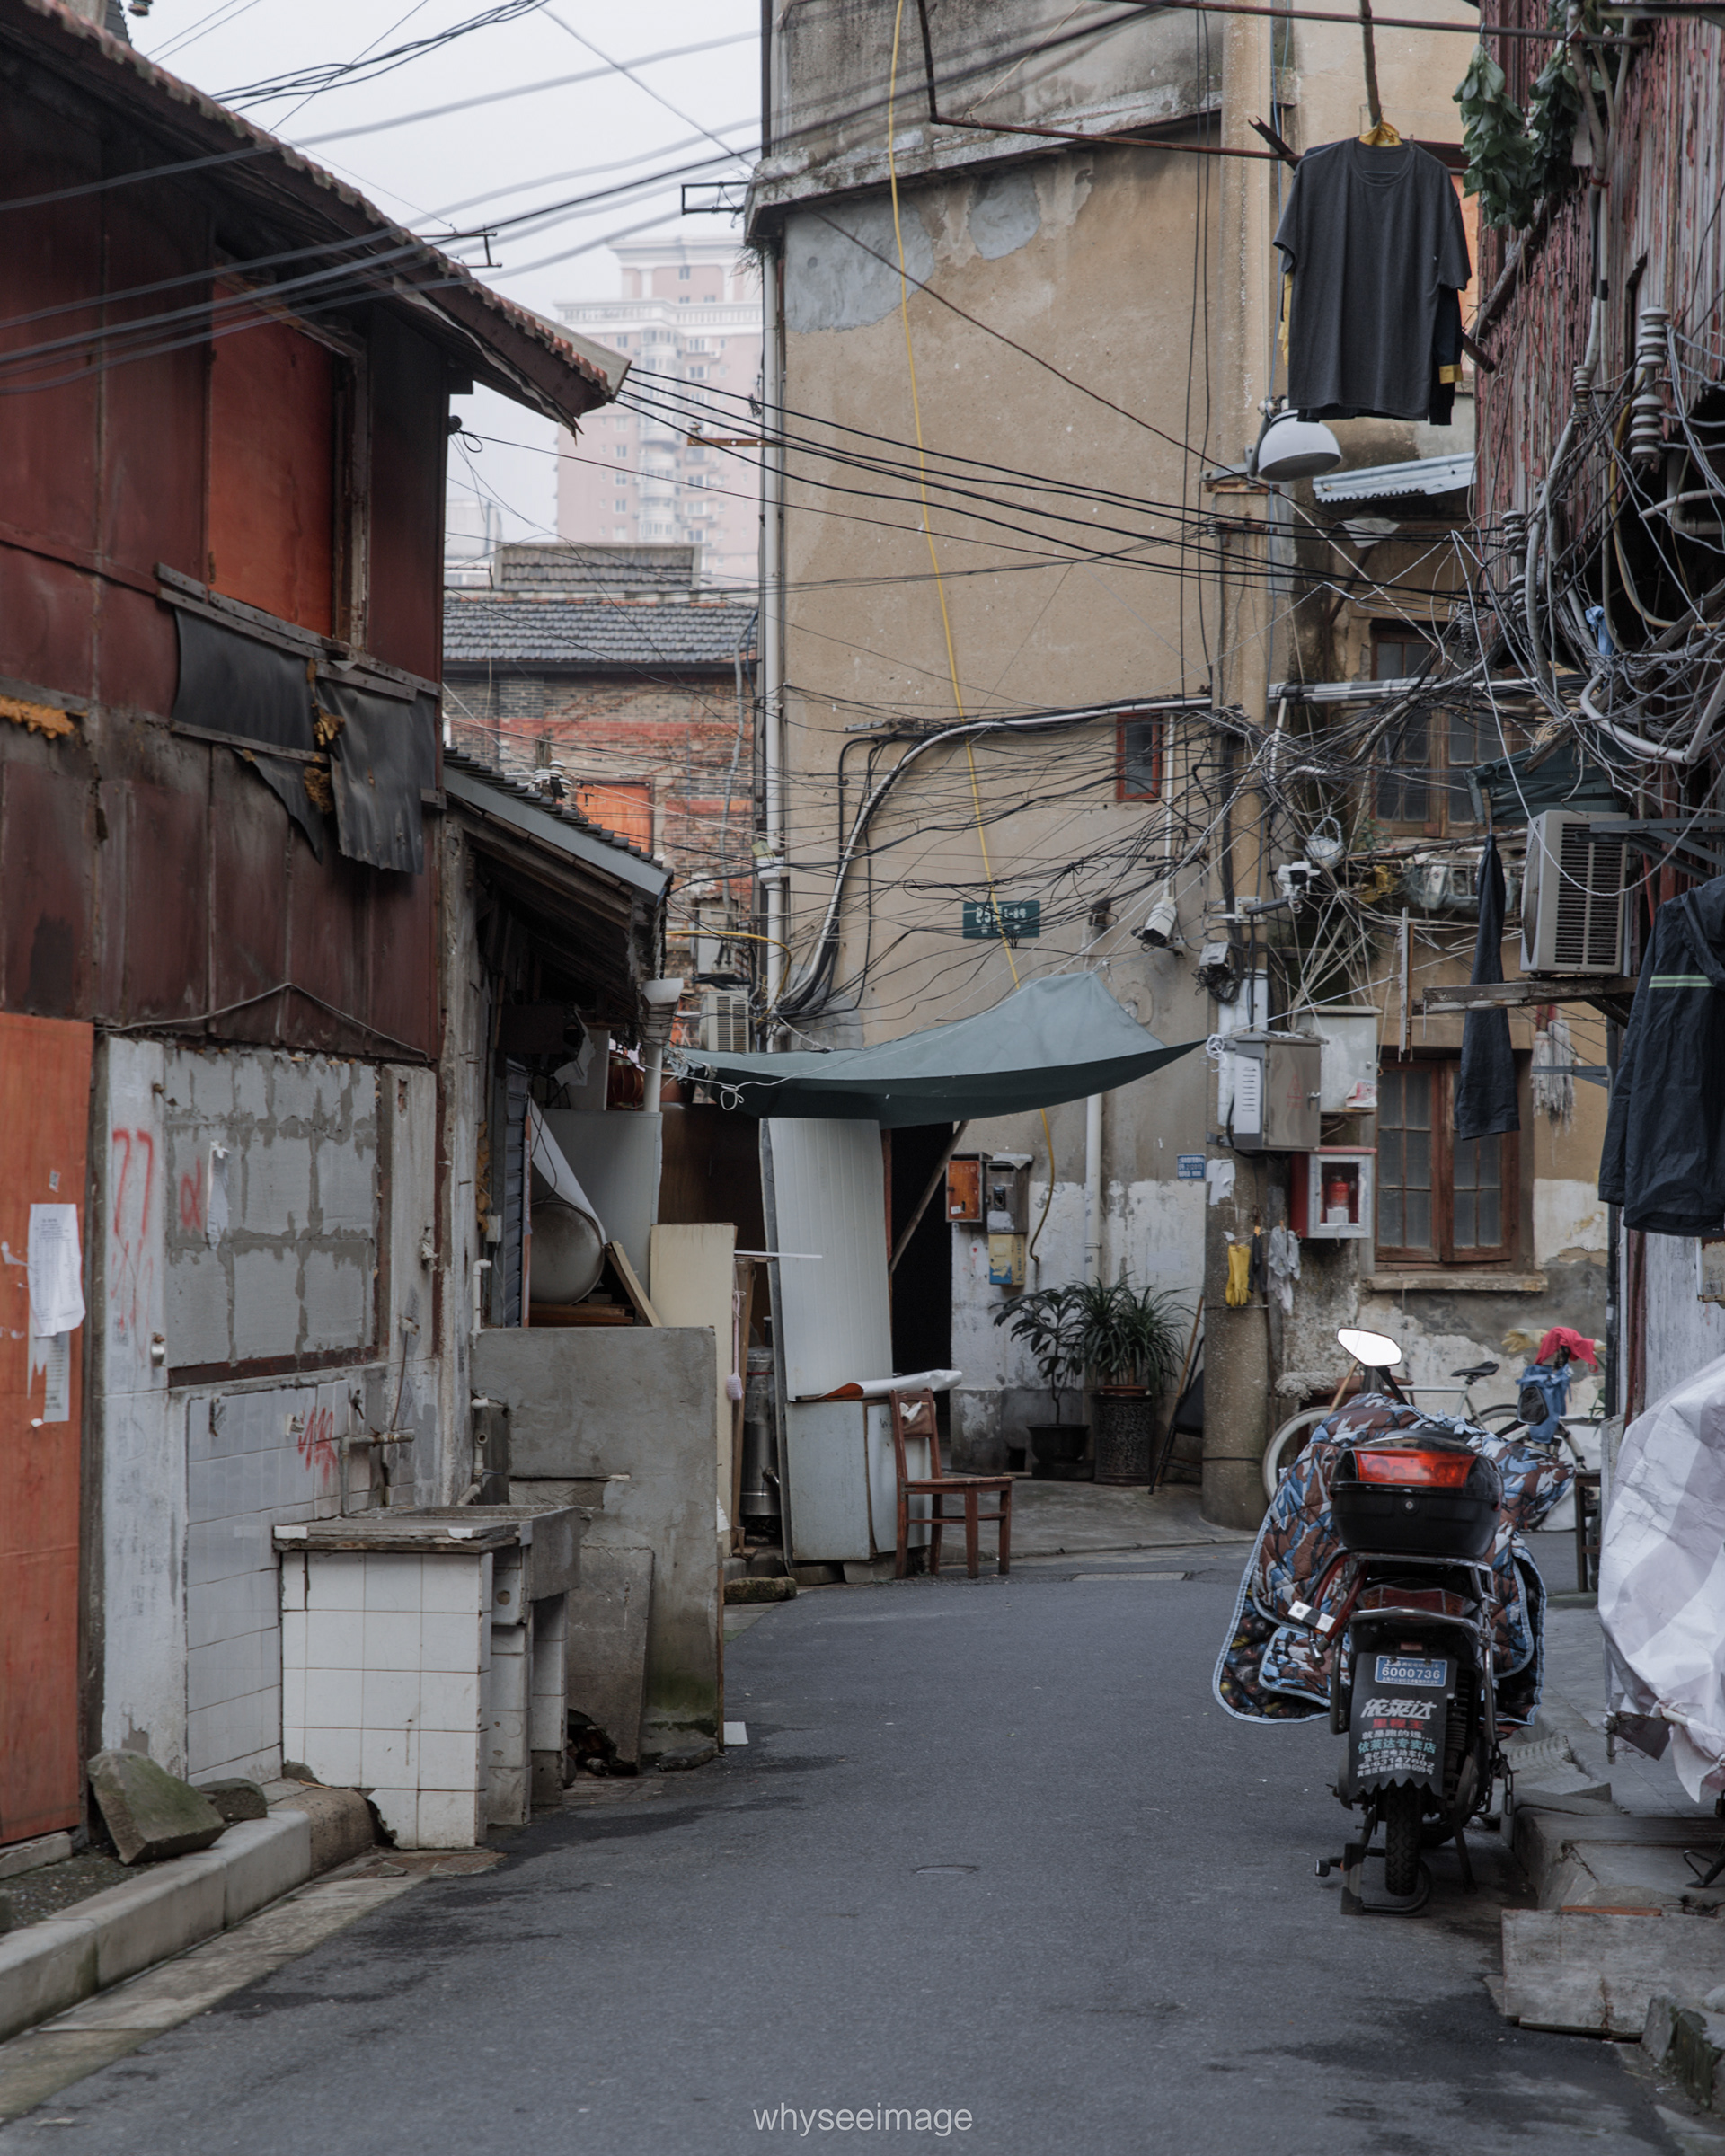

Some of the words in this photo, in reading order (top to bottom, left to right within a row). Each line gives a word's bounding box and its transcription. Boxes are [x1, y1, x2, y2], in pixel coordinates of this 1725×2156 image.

[1381, 1666, 1441, 1680] 6000736
[1360, 1699, 1438, 1719] 依莱达
[1358, 1738, 1437, 1754] 依莱达专卖店
